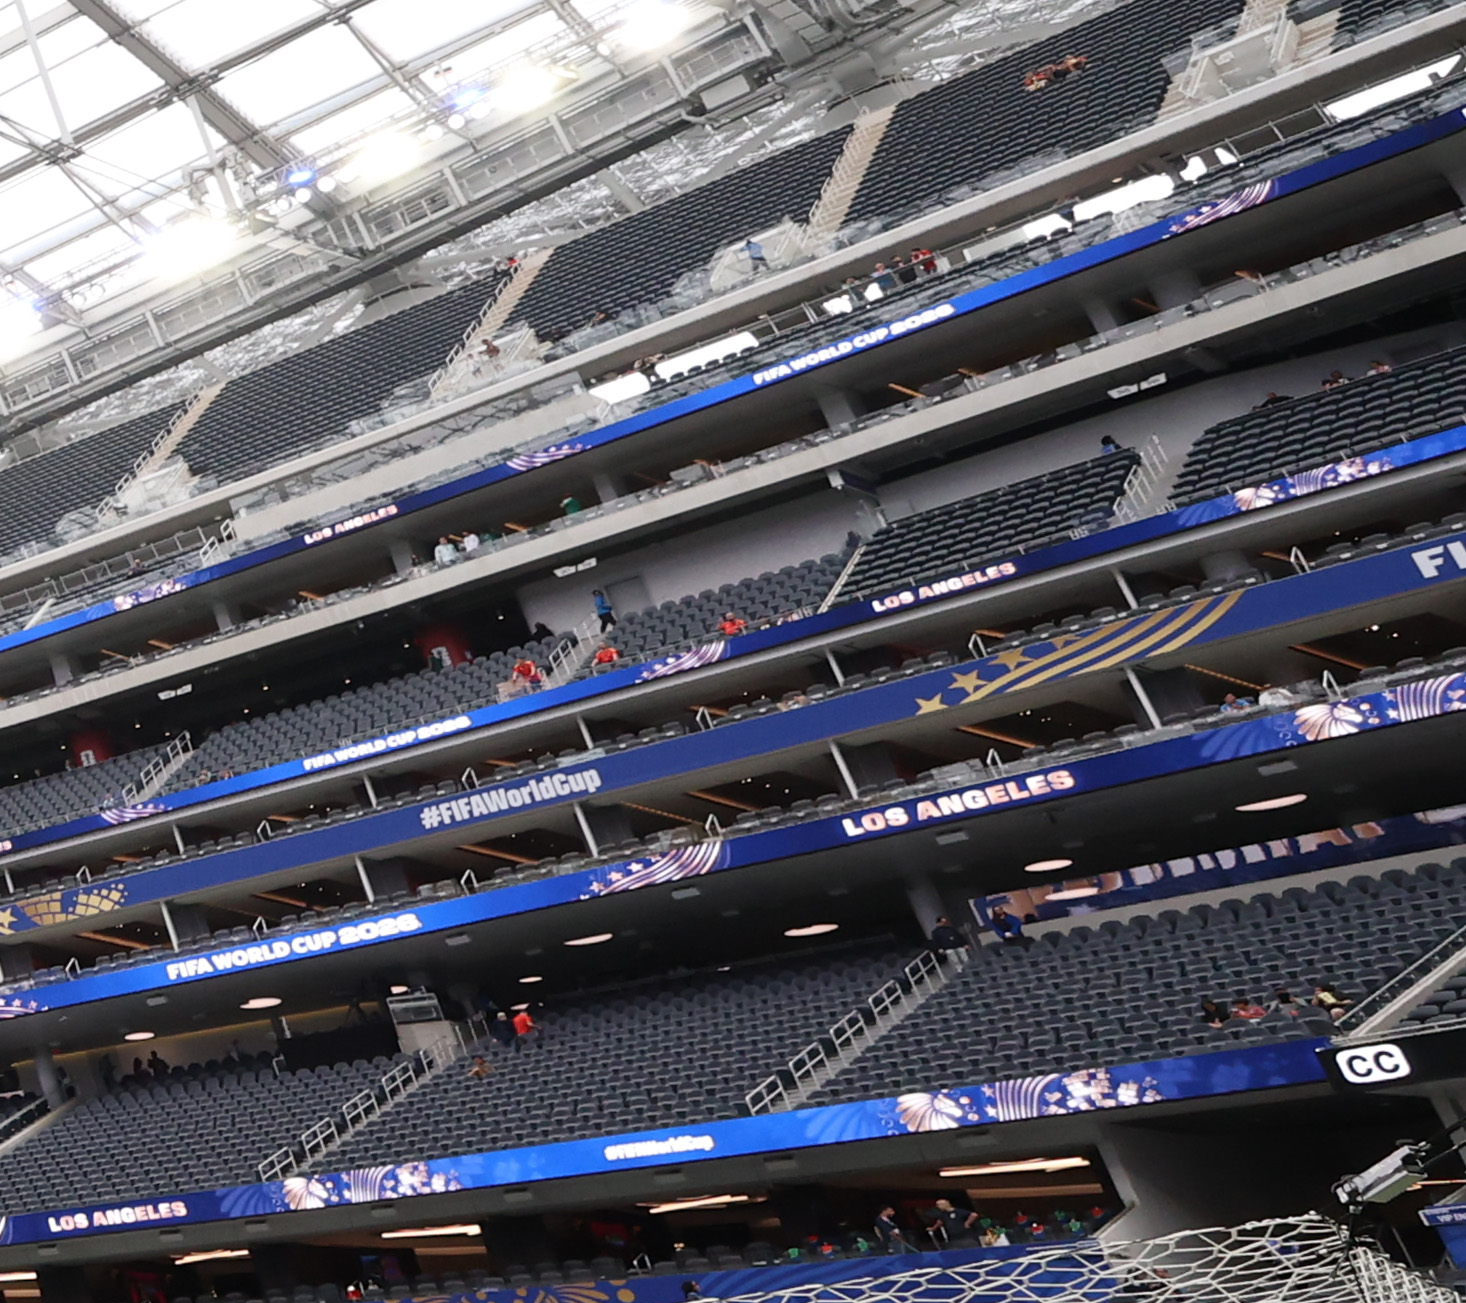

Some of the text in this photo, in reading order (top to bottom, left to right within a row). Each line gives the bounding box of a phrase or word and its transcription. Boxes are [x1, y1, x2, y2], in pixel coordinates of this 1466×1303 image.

[752, 364, 793, 385] FIFA
[788, 341, 854, 371] WORLD
[851, 327, 890, 348] CUP
[871, 562, 1016, 612] LOS ANGELES
[302, 753, 337, 771] FIFA
[333, 738, 388, 762] WORLD
[385, 730, 418, 748] CUP
[419, 769, 602, 828] #FIFAWorldCup
[841, 770, 1075, 836] LOS ANGELES
[165, 957, 215, 980] FIFA
[210, 940, 292, 971] WORLD
[290, 930, 338, 954] CUP
[1346, 1051, 1400, 1078] CC
[47, 1201, 188, 1232] LOS ANGELES
